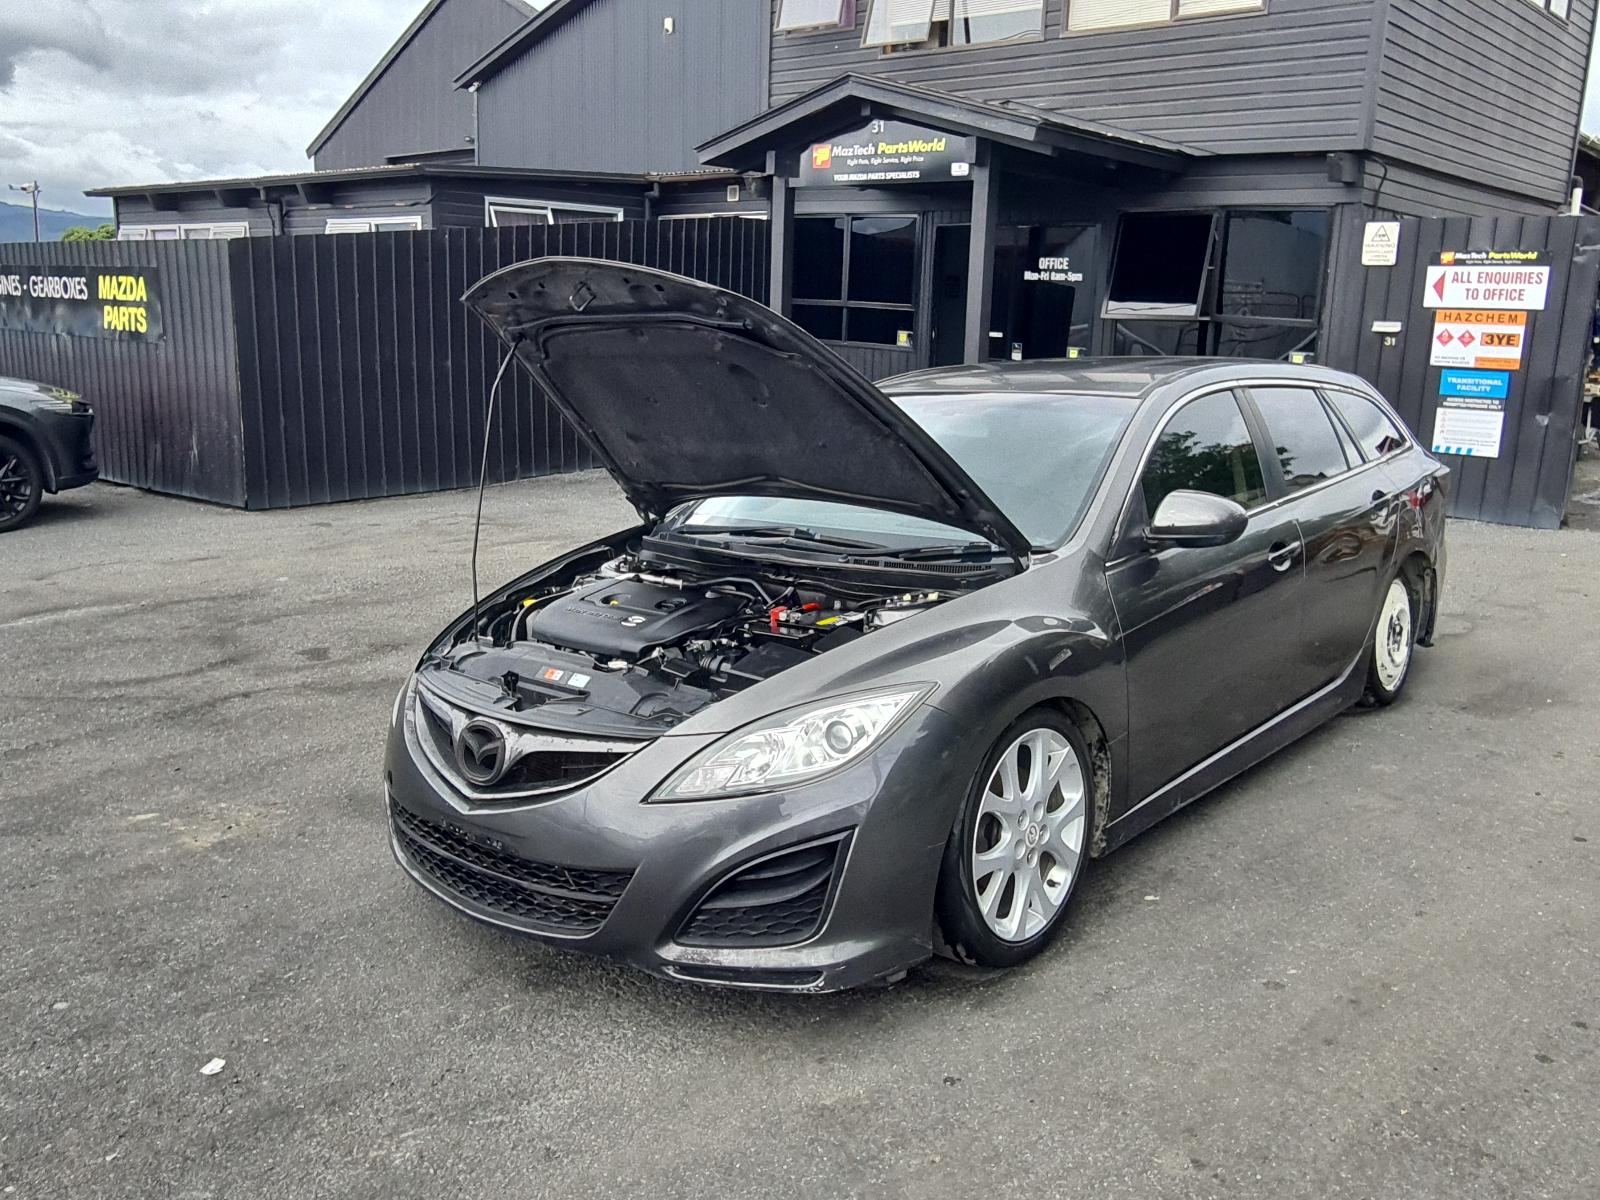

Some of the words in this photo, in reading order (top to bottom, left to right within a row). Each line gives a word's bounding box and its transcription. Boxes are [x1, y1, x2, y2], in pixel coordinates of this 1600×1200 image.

[871, 120, 885, 133] 31
[832, 143, 875, 157] MazTech
[877, 138, 946, 155] PartsWorld
[868, 172, 885, 180] PARTS
[885, 171, 920, 179] SPECIALISTS
[1455, 251, 1487, 259] MazTech
[1488, 251, 1538, 260] PartsWorld
[1039, 257, 1070, 269] OFFICE
[1451, 271, 1472, 284] ALL
[1477, 271, 1544, 285] ENQUIRIES
[0, 275, 21, 296] INES
[29, 275, 88, 300] GEARBOXES
[98, 275, 147, 302] MAZDA
[1465, 288, 1480, 300] TO
[1483, 288, 1526, 301] OFFICE
[103, 305, 147, 333] PARTS
[1443, 311, 1518, 324] HAZCHEM
[1384, 336, 1396, 346] 31
[1485, 333, 1516, 346] 3YE
[1447, 377, 1503, 386] TRANSITIONAL
[1456, 384, 1491, 392] FACILITY
